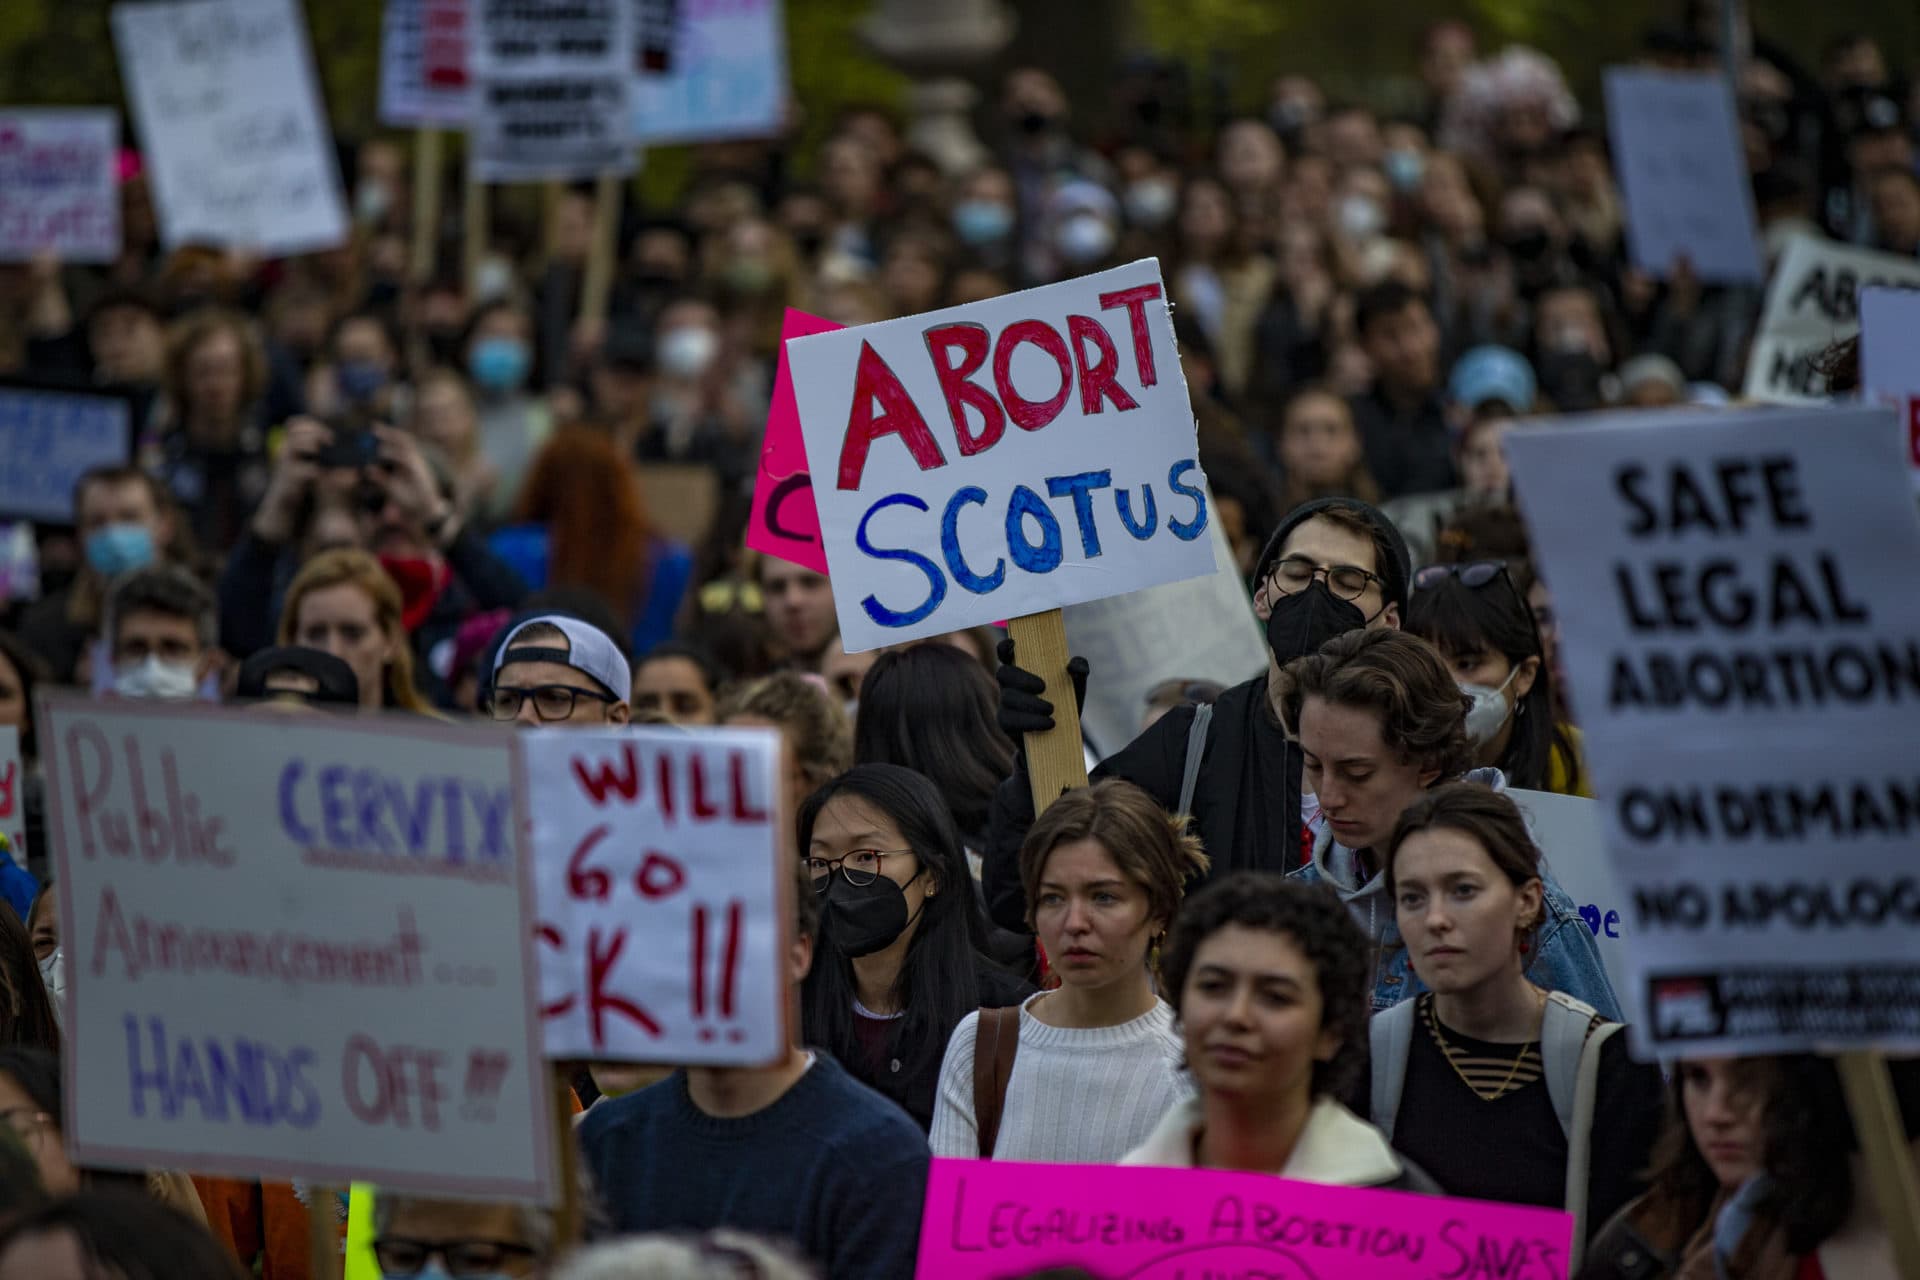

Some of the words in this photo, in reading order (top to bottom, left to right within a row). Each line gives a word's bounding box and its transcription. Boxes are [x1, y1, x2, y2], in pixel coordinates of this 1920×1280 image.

[837, 283, 1161, 490] ABORT
[1612, 452, 1812, 540] SAFE
[856, 459, 1207, 628] SCOTUS
[1612, 550, 1871, 633] LEGAL
[1606, 641, 1920, 712] ABORTION
[65, 720, 235, 868] Public
[277, 757, 514, 864] CERVIX
[570, 739, 770, 828] WILL
[1619, 785, 1711, 841] ON
[1633, 882, 1709, 931] NO
[122, 1011, 323, 1130] HANDS
[341, 1032, 448, 1132] OFF
[950, 1176, 1186, 1252] LEGALIZING
[1208, 1193, 1426, 1262] ABORTION
